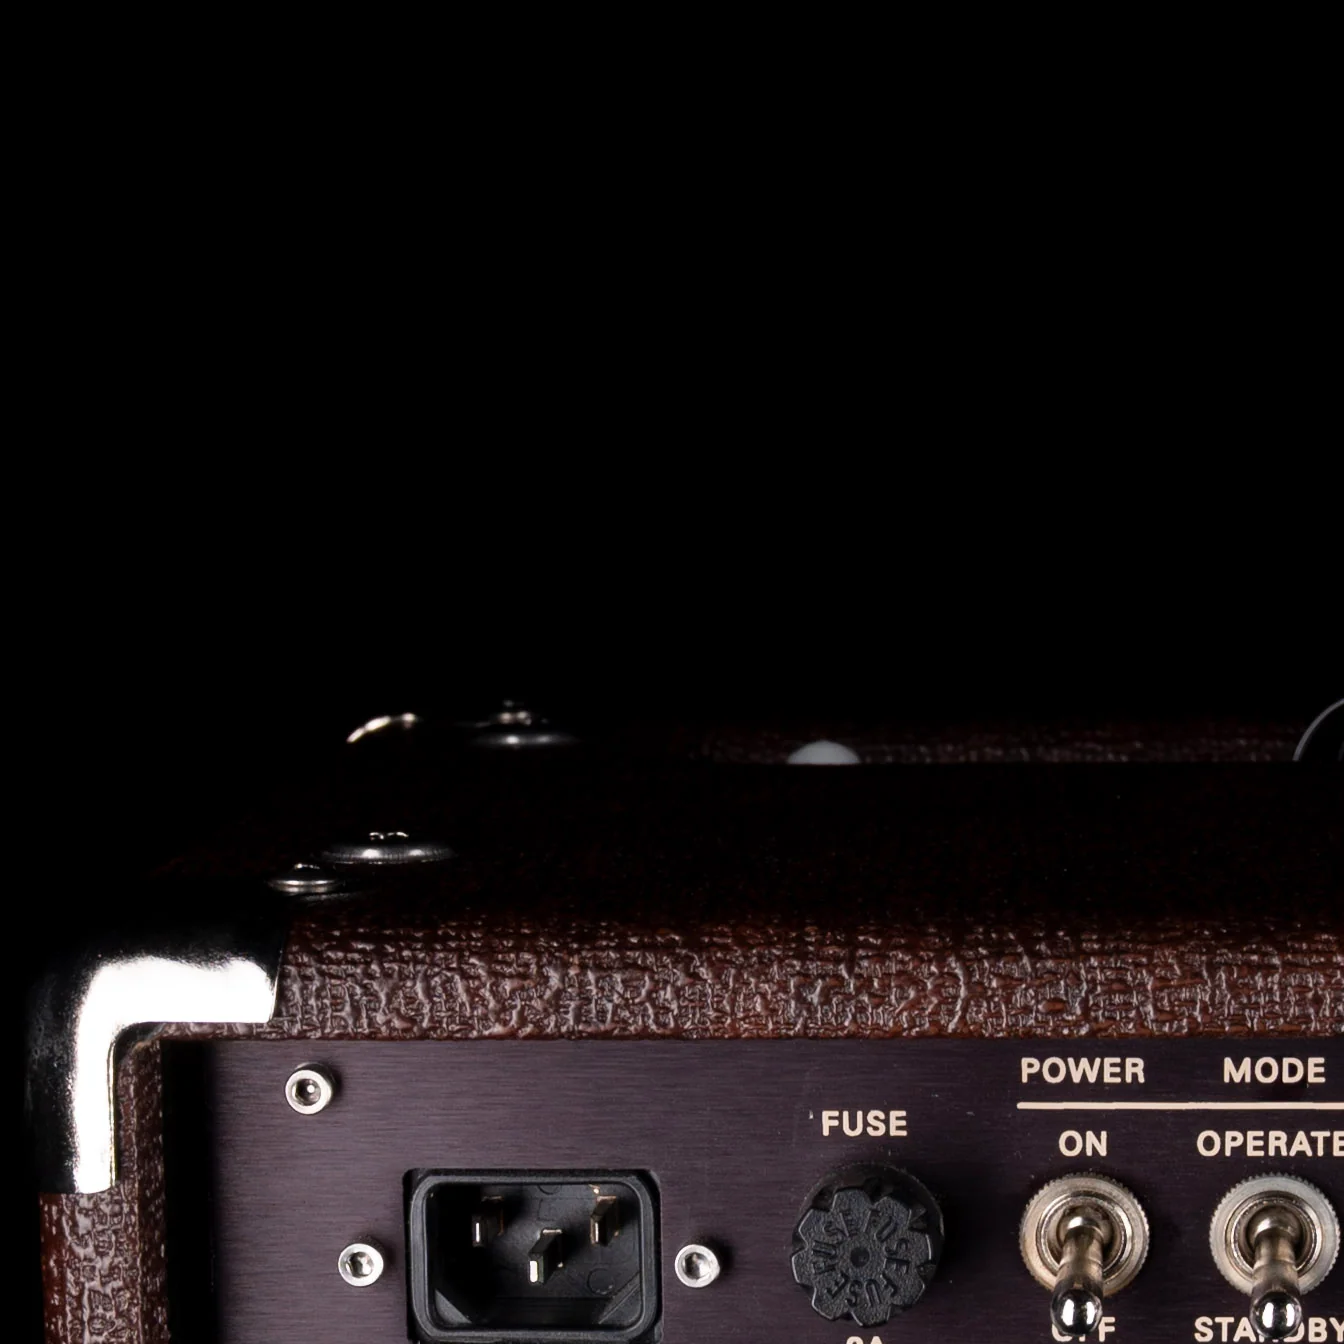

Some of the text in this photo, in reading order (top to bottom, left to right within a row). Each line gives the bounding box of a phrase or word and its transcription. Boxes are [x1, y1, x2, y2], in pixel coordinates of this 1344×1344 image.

[1021, 1056, 1145, 1084] POWER
[1223, 1056, 1326, 1084] MODE
[821, 1109, 908, 1137] FUSE
[1058, 1130, 1108, 1157] ON
